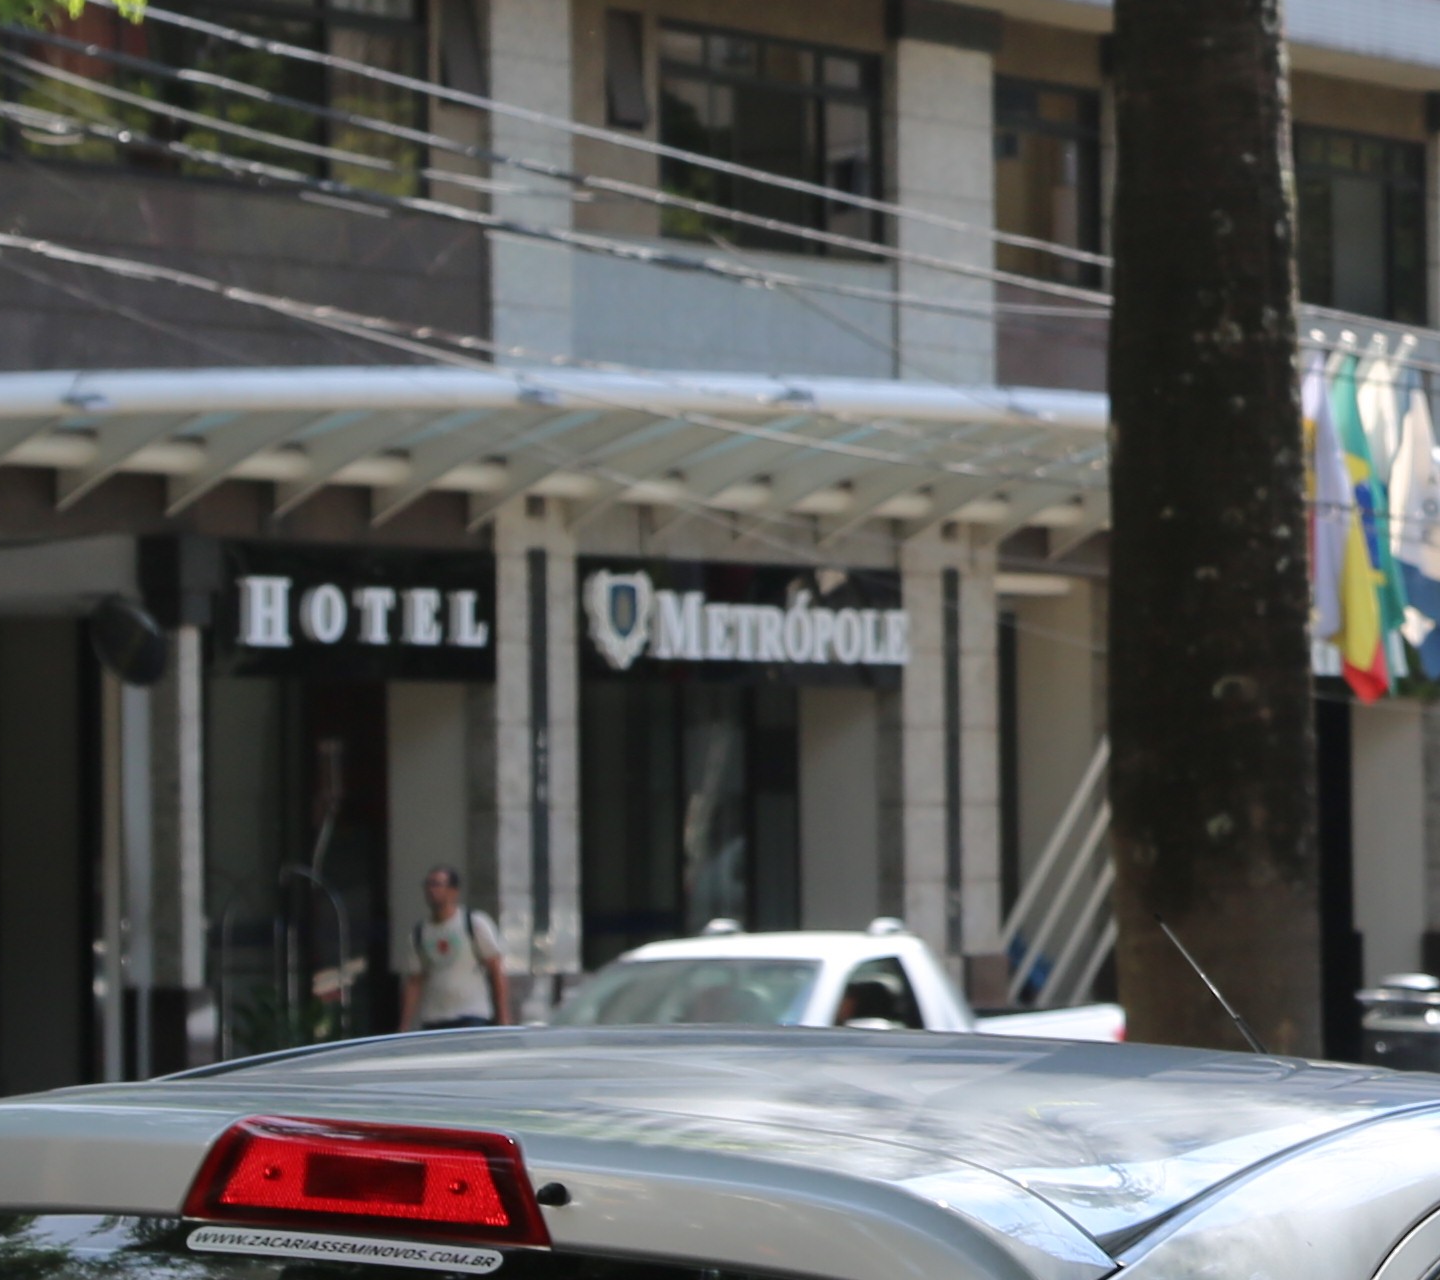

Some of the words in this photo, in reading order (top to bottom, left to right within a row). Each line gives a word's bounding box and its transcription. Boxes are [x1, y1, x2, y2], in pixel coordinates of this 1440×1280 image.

[237, 575, 488, 648] HOTEL
[650, 588, 908, 665] METRÓPOLE
[194, 1230, 496, 1268] WWW.ZACARIASSEMINOVOS.COM.BR
